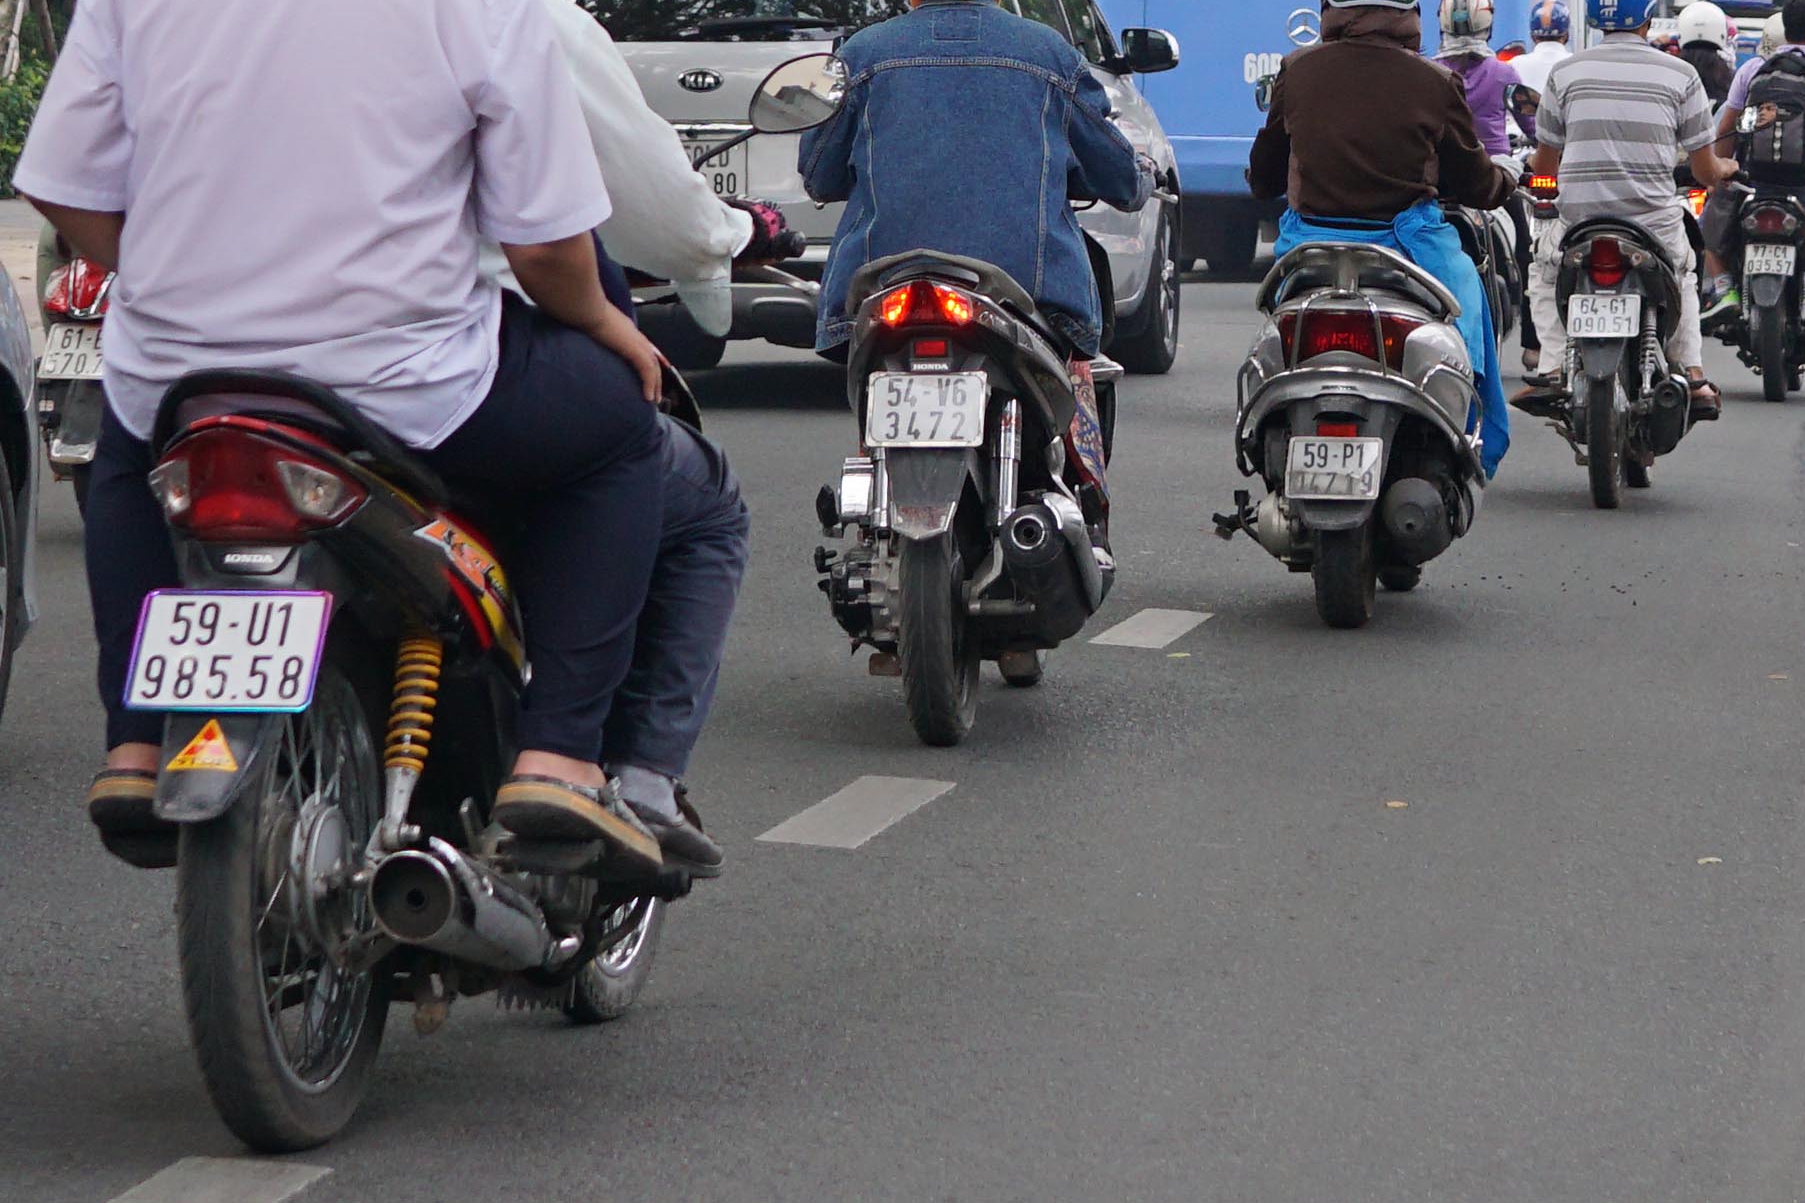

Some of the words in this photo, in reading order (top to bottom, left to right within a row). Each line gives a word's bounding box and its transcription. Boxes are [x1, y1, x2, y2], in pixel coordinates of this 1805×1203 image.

[684, 72, 717, 89] KIA
[1580, 298, 1627, 315] 64-G1
[912, 363, 950, 371] HONDA
[887, 378, 967, 407] 54-V6
[885, 411, 966, 440] 3472
[1303, 442, 1365, 469] 59-P1
[169, 601, 294, 647] 59-U1
[141, 654, 304, 699] 985.58
